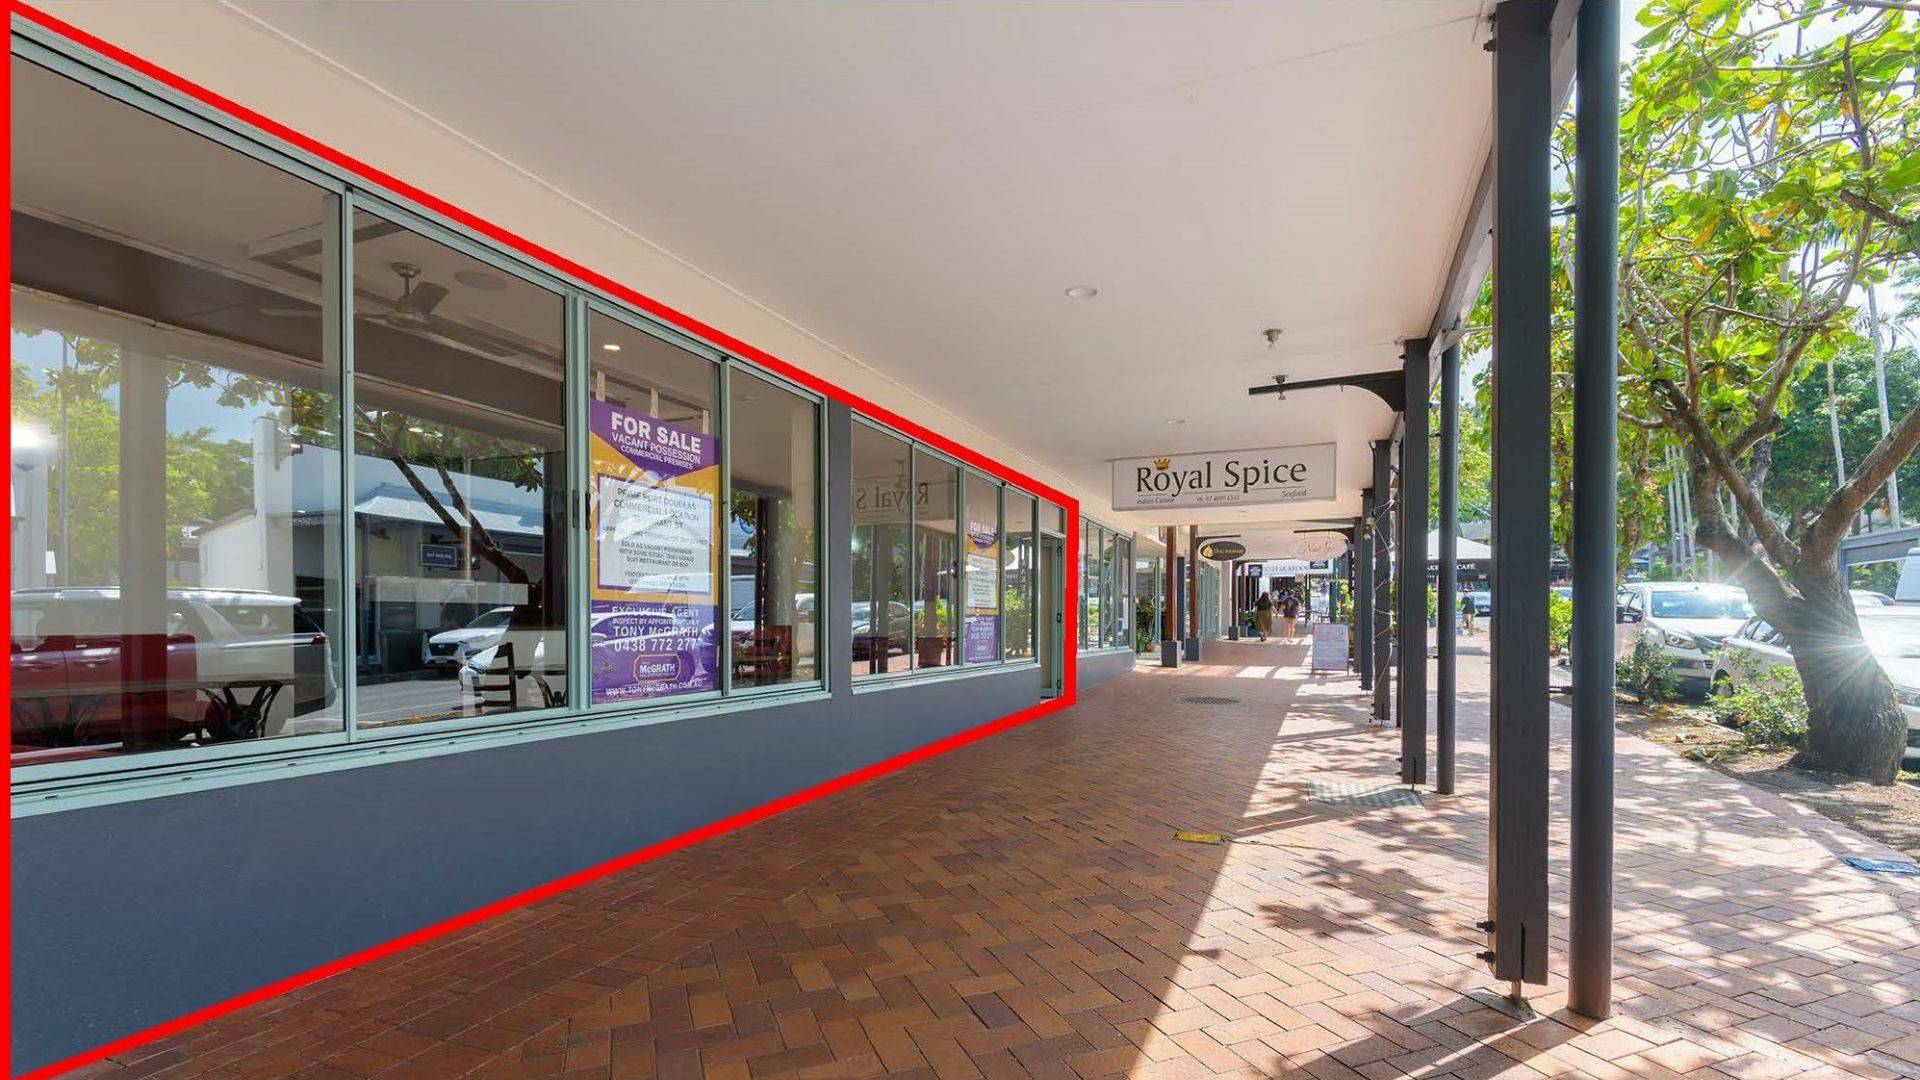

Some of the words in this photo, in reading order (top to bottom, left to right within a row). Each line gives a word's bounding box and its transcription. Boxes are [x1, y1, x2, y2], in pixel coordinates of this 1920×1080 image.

[611, 412, 651, 440] FOR
[657, 426, 701, 454] SALE
[612, 432, 649, 449] VACANT
[650, 443, 701, 464] POSSESSION
[620, 445, 663, 462] COMMERCIAL
[664, 456, 693, 470] PREMISES
[1136, 461, 1212, 497] Royal
[1224, 459, 1307, 493] Spice
[671, 608, 699, 618] AGENT
[613, 626, 645, 637] TONY
[649, 626, 699, 637] McGRATH
[613, 638, 646, 651] 0438
[651, 638, 673, 651] 772
[677, 638, 697, 651] 277
[640, 663, 675, 674] McGRATH
